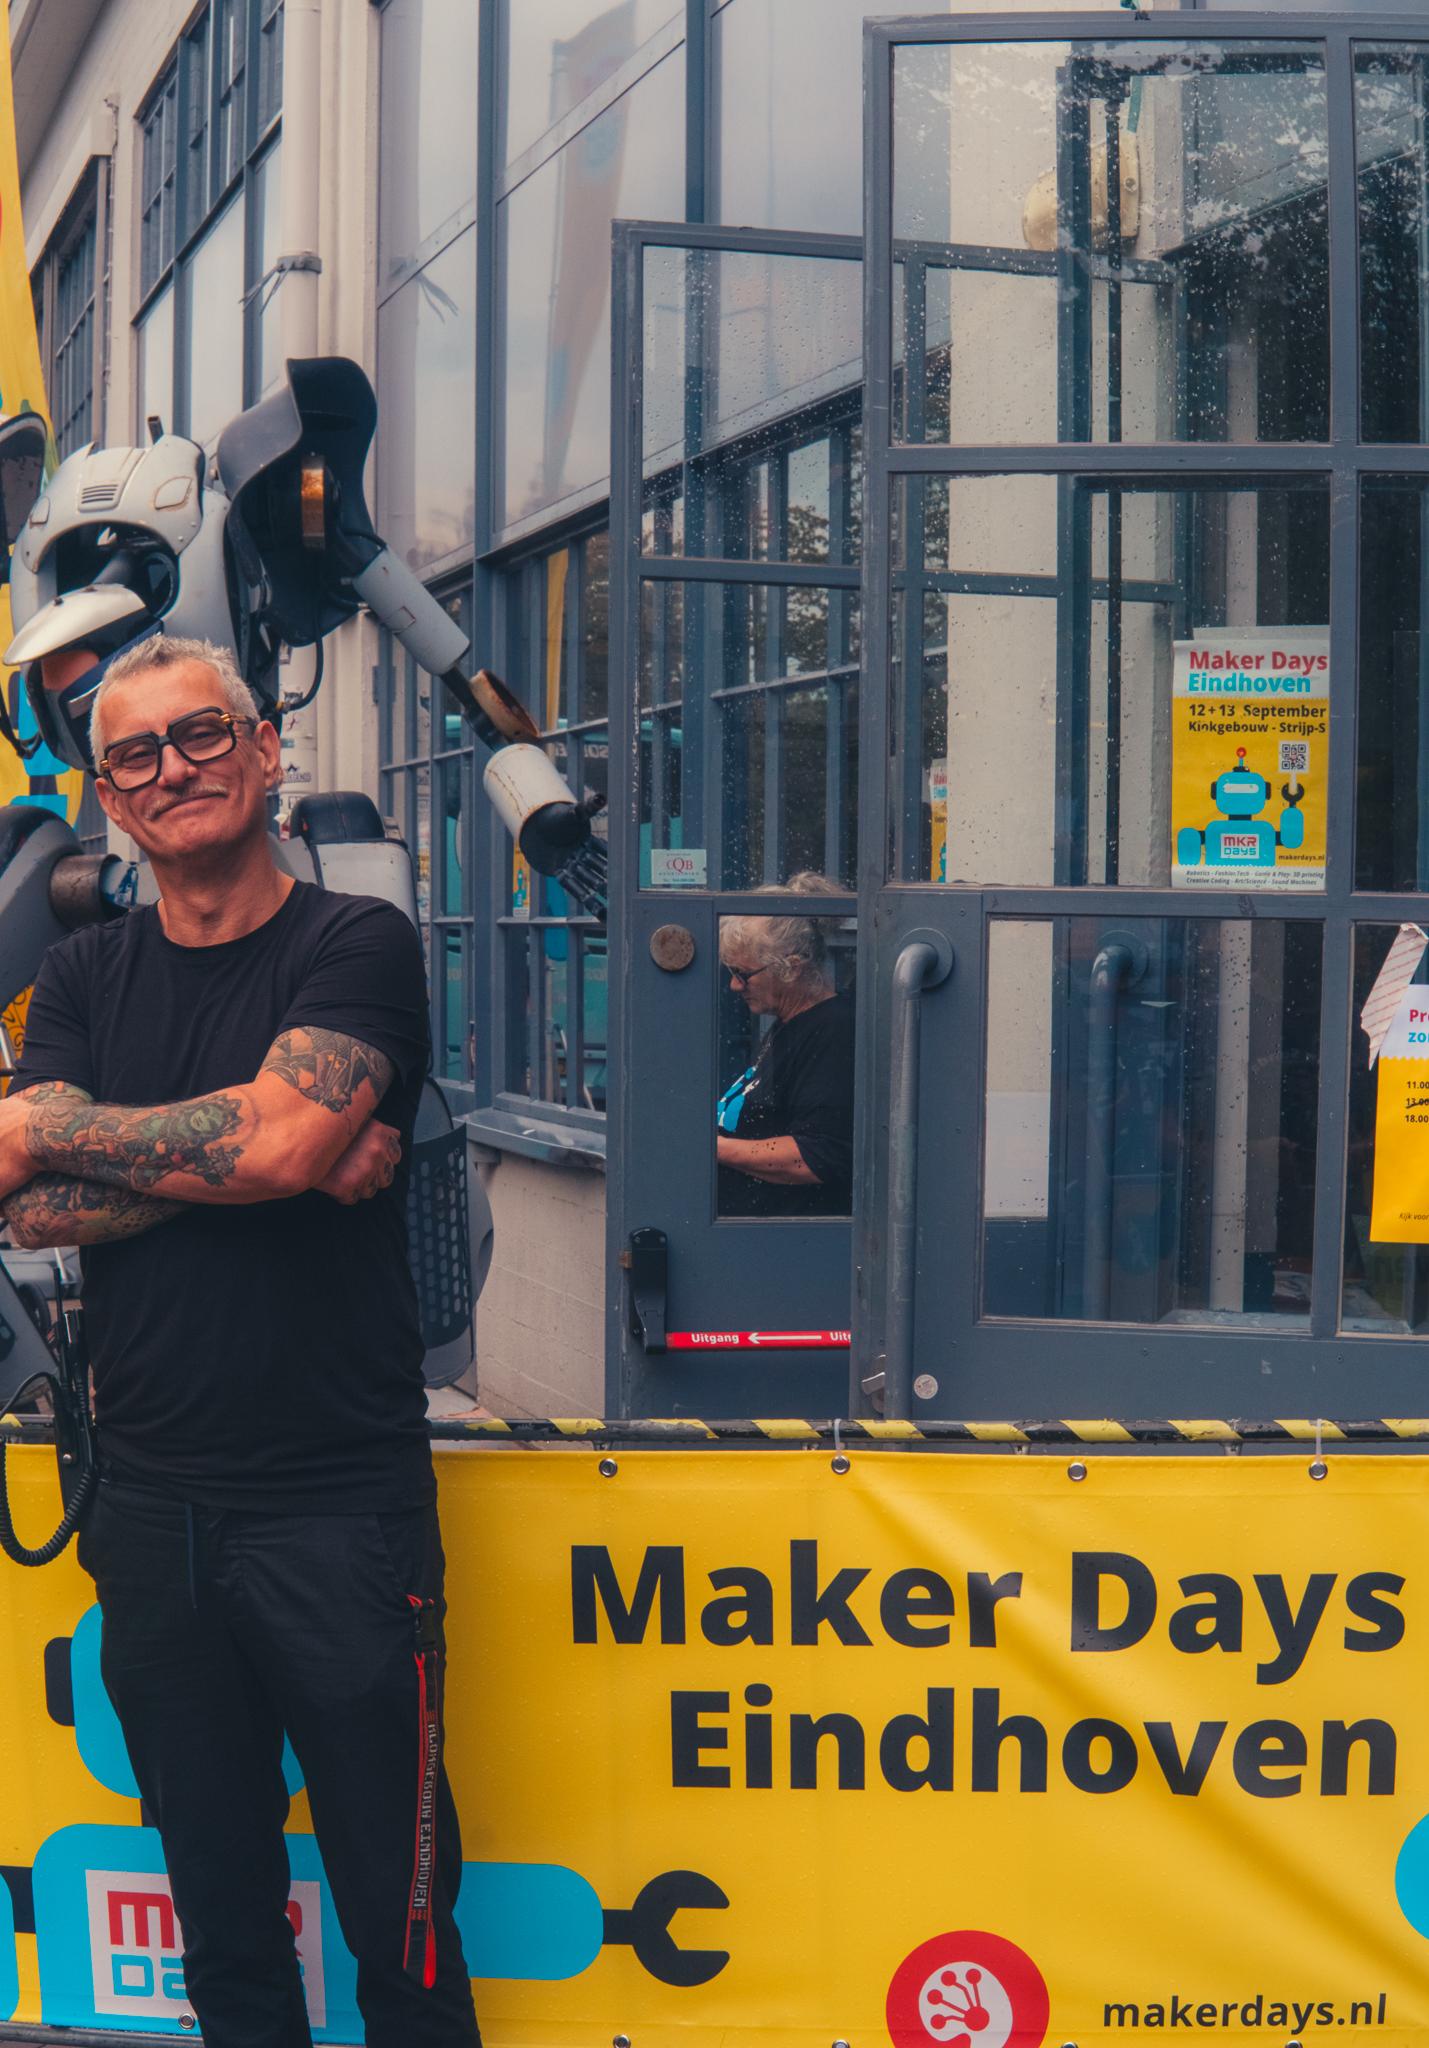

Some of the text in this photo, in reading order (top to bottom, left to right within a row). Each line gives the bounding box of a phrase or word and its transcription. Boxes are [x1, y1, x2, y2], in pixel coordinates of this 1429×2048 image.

[1189, 650, 1328, 675] Maker Days
[1188, 672, 1311, 693] Eindhoven
[1243, 704, 1327, 720] September
[1279, 722, 1327, 736] Strijp-S
[1223, 836, 1257, 847] MKR
[1278, 854, 1325, 862] makerdays.nl
[1409, 1009, 1429, 1023] Pr
[1407, 1032, 1429, 1043] zo
[691, 1333, 739, 1344] Uitgang
[570, 1539, 1407, 1686] Maker Days
[670, 1683, 1398, 1798] Eindhoven
[413, 1823, 432, 1907] EINDHOVEN
[1103, 1993, 1387, 2035] makerdays.nl
